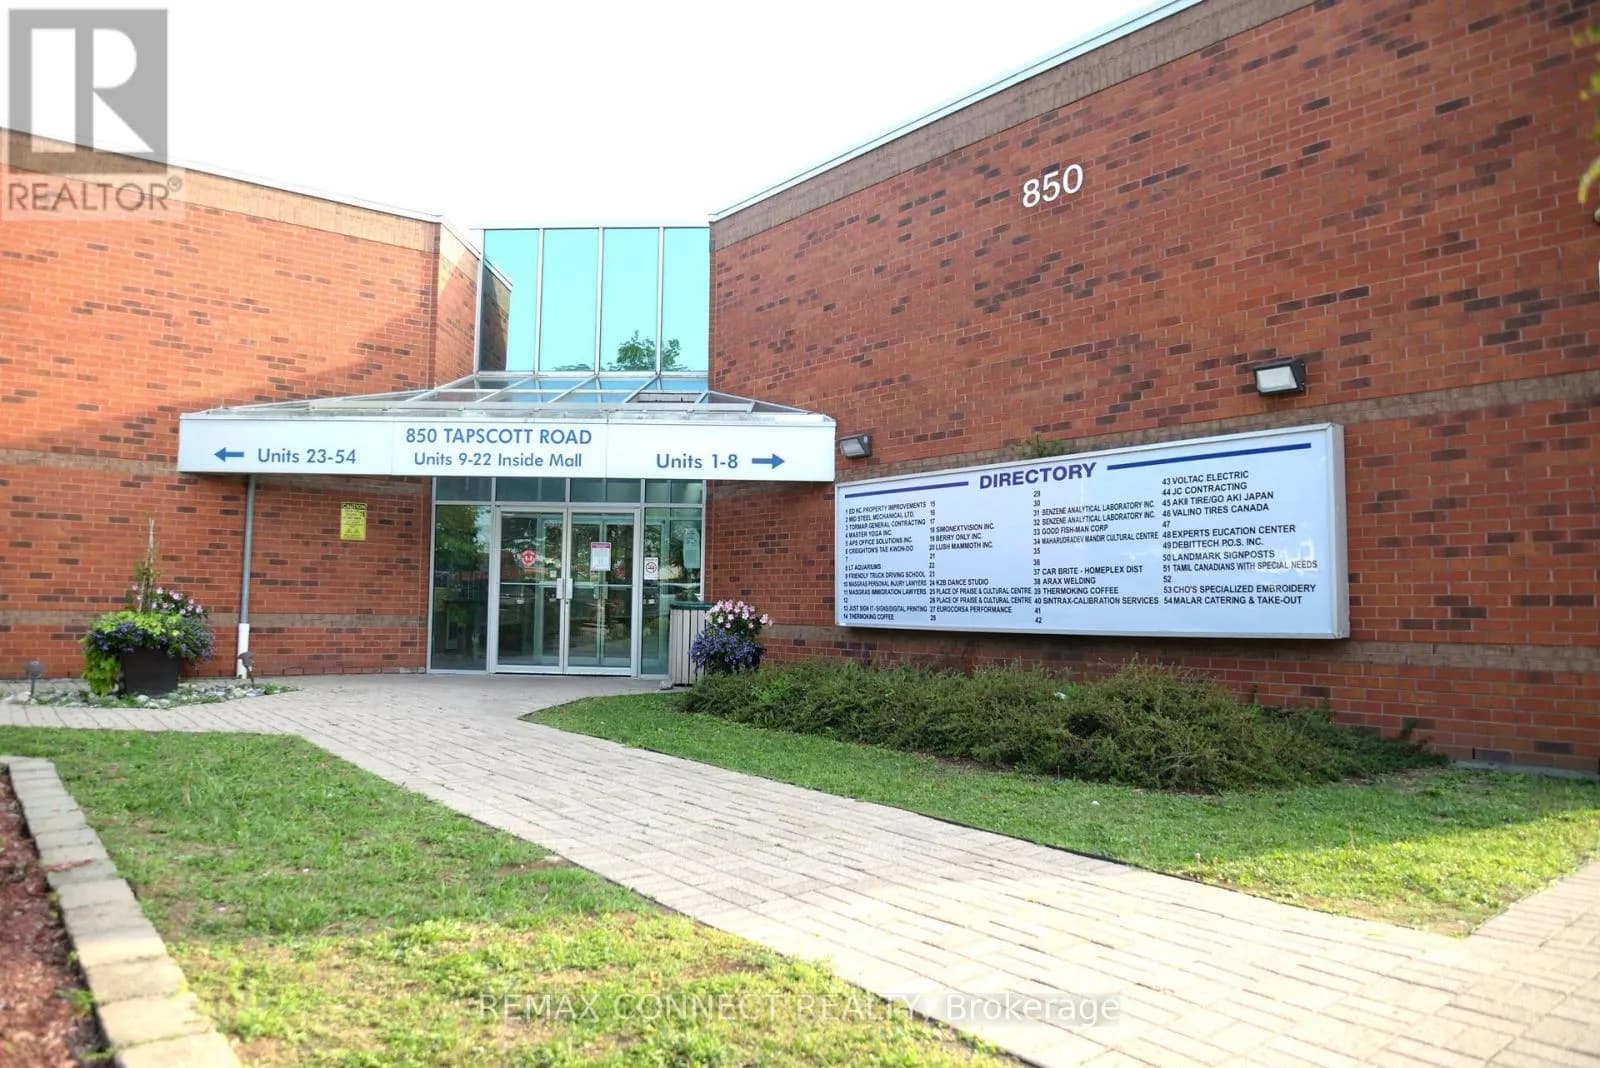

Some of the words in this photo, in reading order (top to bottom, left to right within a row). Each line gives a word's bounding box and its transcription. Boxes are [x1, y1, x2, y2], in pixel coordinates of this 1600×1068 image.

[1022, 163, 1083, 208] 850
[405, 428, 437, 443] 850
[443, 428, 533, 444] TAPSCOTT
[539, 429, 592, 445] ROAD
[257, 448, 300, 464] Units
[306, 448, 356, 464] 23-54
[413, 452, 452, 466] Units
[458, 452, 491, 467] 9-22
[498, 453, 544, 467] Inside
[549, 453, 582, 467] Mall
[656, 453, 703, 469] Units
[712, 454, 738, 469] 1-8
[980, 462, 1096, 489] DIRECTORY
[1171, 475, 1204, 485] VOLTAC
[1206, 470, 1249, 482] ELECTRIC
[1034, 490, 1040, 498] 29
[1162, 488, 1171, 496] 44
[1185, 482, 1247, 495] CONTRACTING
[1226, 494, 1242, 502] AKI
[1244, 491, 1274, 501] JAPAN
[888, 501, 927, 510] IMPROVEMENTS
[1041, 507, 1066, 516] BENZENE
[1067, 505, 1101, 514] ANALYTICAL
[1102, 501, 1142, 512] LABORATORY
[1172, 507, 1202, 517] VALINO
[1204, 505, 1229, 515] TIRES
[1230, 503, 1269, 513] CANADA
[873, 512, 903, 520] MECHANICAL
[1041, 517, 1066, 525] BENZENE
[1067, 514, 1101, 524] ANALYTICAL
[1102, 511, 1142, 522] LABORATORY
[891, 519, 925, 527] CONTRACTING
[1041, 527, 1059, 535] GOOD
[1060, 525, 1089, 534] FISH-MAN
[1090, 524, 1109, 532] CORP
[1162, 531, 1172, 539] 48
[1172, 529, 1210, 539] EXPERTS
[1212, 526, 1256, 537] EUCATION
[1258, 524, 1296, 534] CENTER
[936, 534, 955, 542] BERRY
[1106, 533, 1135, 542] CULTURAL
[1135, 531, 1159, 540] CENTRE
[1162, 541, 1172, 549] 49
[1172, 540, 1219, 549] DEBITTECH
[1246, 538, 1264, 546] INC.
[1172, 552, 1220, 561] LANDMARK
[1223, 550, 1275, 560] SIGNPOSTS
[1058, 567, 1078, 575] BRITE
[1084, 566, 1125, 574] HOMEPLEX
[1126, 565, 1143, 573] DIST
[1173, 564, 1192, 572] TAMIL
[1194, 562, 1235, 571] CANADIANS
[1236, 562, 1255, 570] WITH
[1257, 561, 1289, 570] SPECIAL
[1291, 560, 1318, 569] NEEDS
[1042, 577, 1062, 585] ARAX
[1010, 587, 1032, 595] CENTRE
[1043, 587, 1088, 595] THERMOKING
[1173, 585, 1197, 594] CHO'S
[1199, 585, 1254, 593] SPECIALIZED
[1256, 584, 1316, 593] EMBROIDERY
[1042, 597, 1120, 605] SINTRAX-CALIBRATION
[1121, 597, 1159, 605] SERVICES
[1173, 596, 1202, 604] MALAR
[1204, 596, 1246, 604] CATERING
[1257, 596, 1303, 604] TAKE-OUT
[1035, 616, 1042, 624] 42
